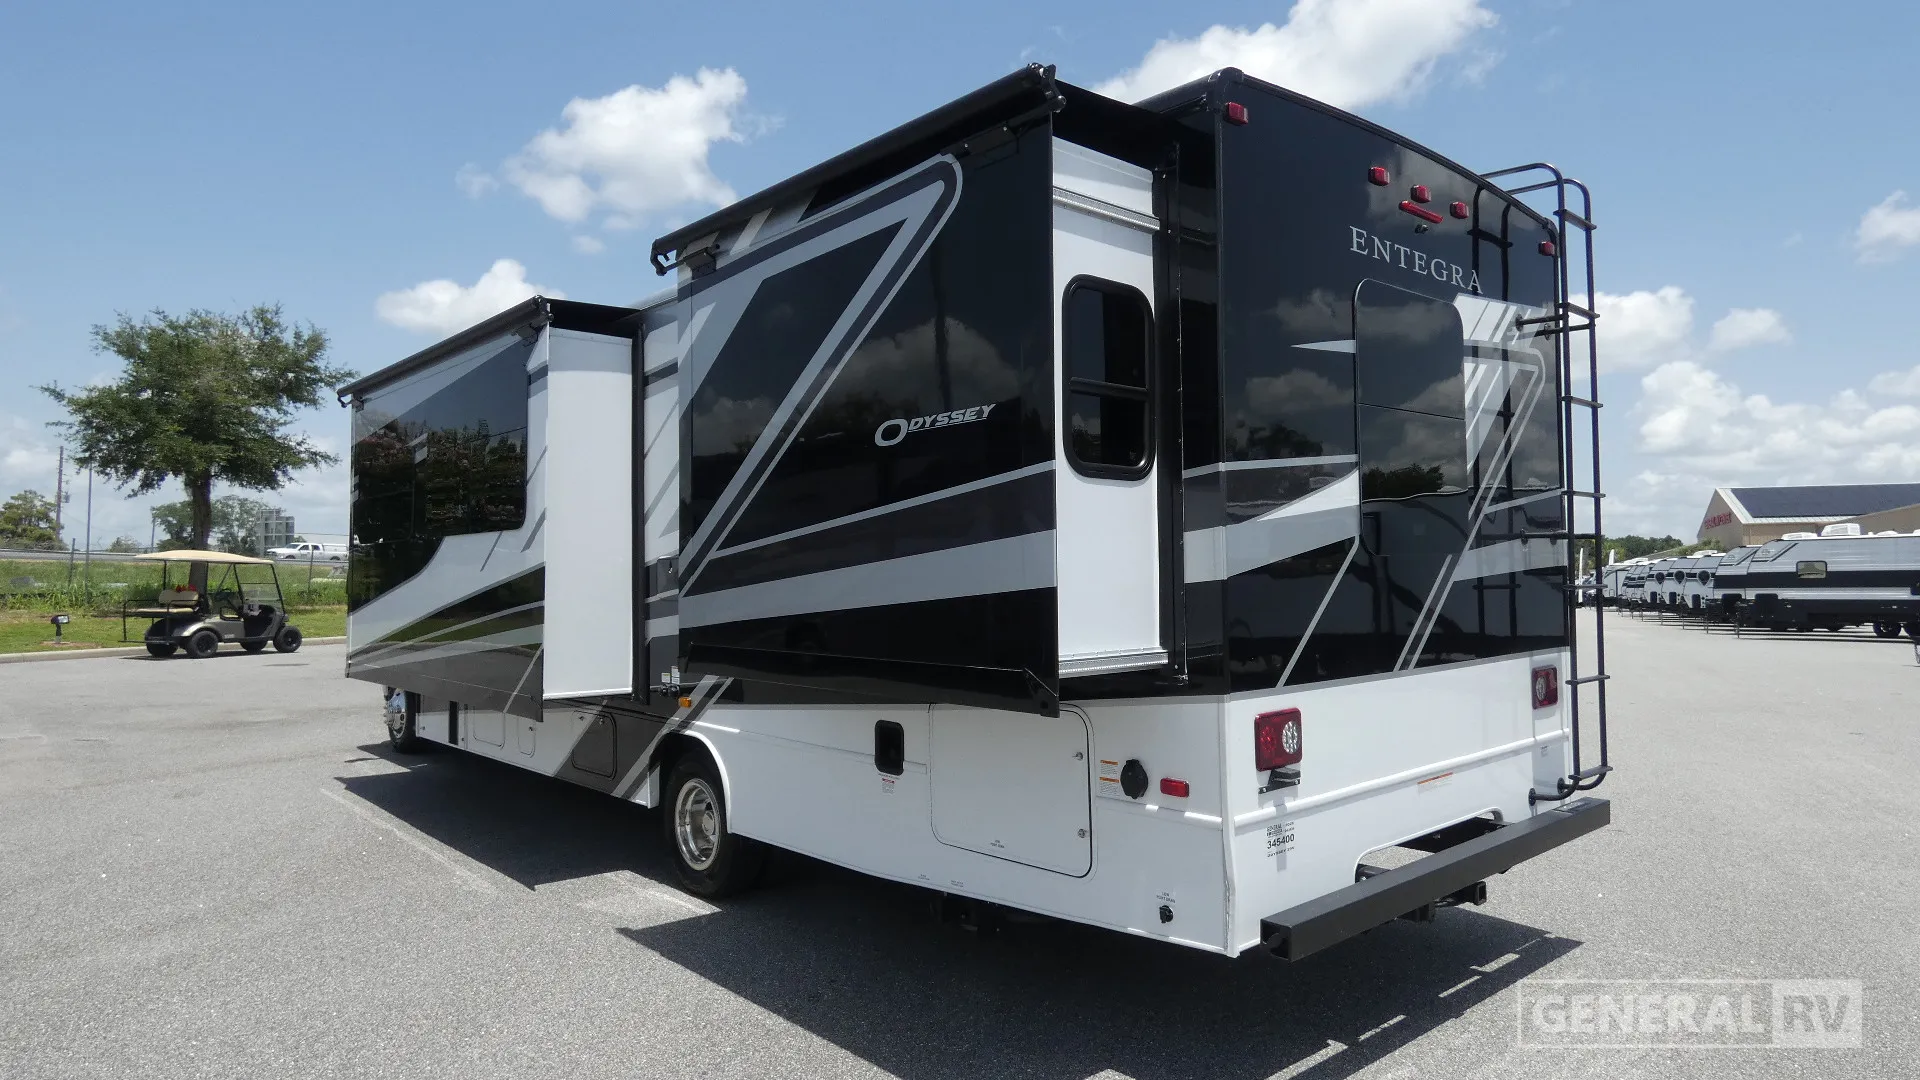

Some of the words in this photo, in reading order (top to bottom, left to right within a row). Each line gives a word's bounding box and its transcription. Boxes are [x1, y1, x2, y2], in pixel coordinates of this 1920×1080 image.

[1349, 225, 1484, 295] ENTEGRA
[874, 403, 997, 447] ODYSSEY
[1266, 833, 1295, 850] 345400
